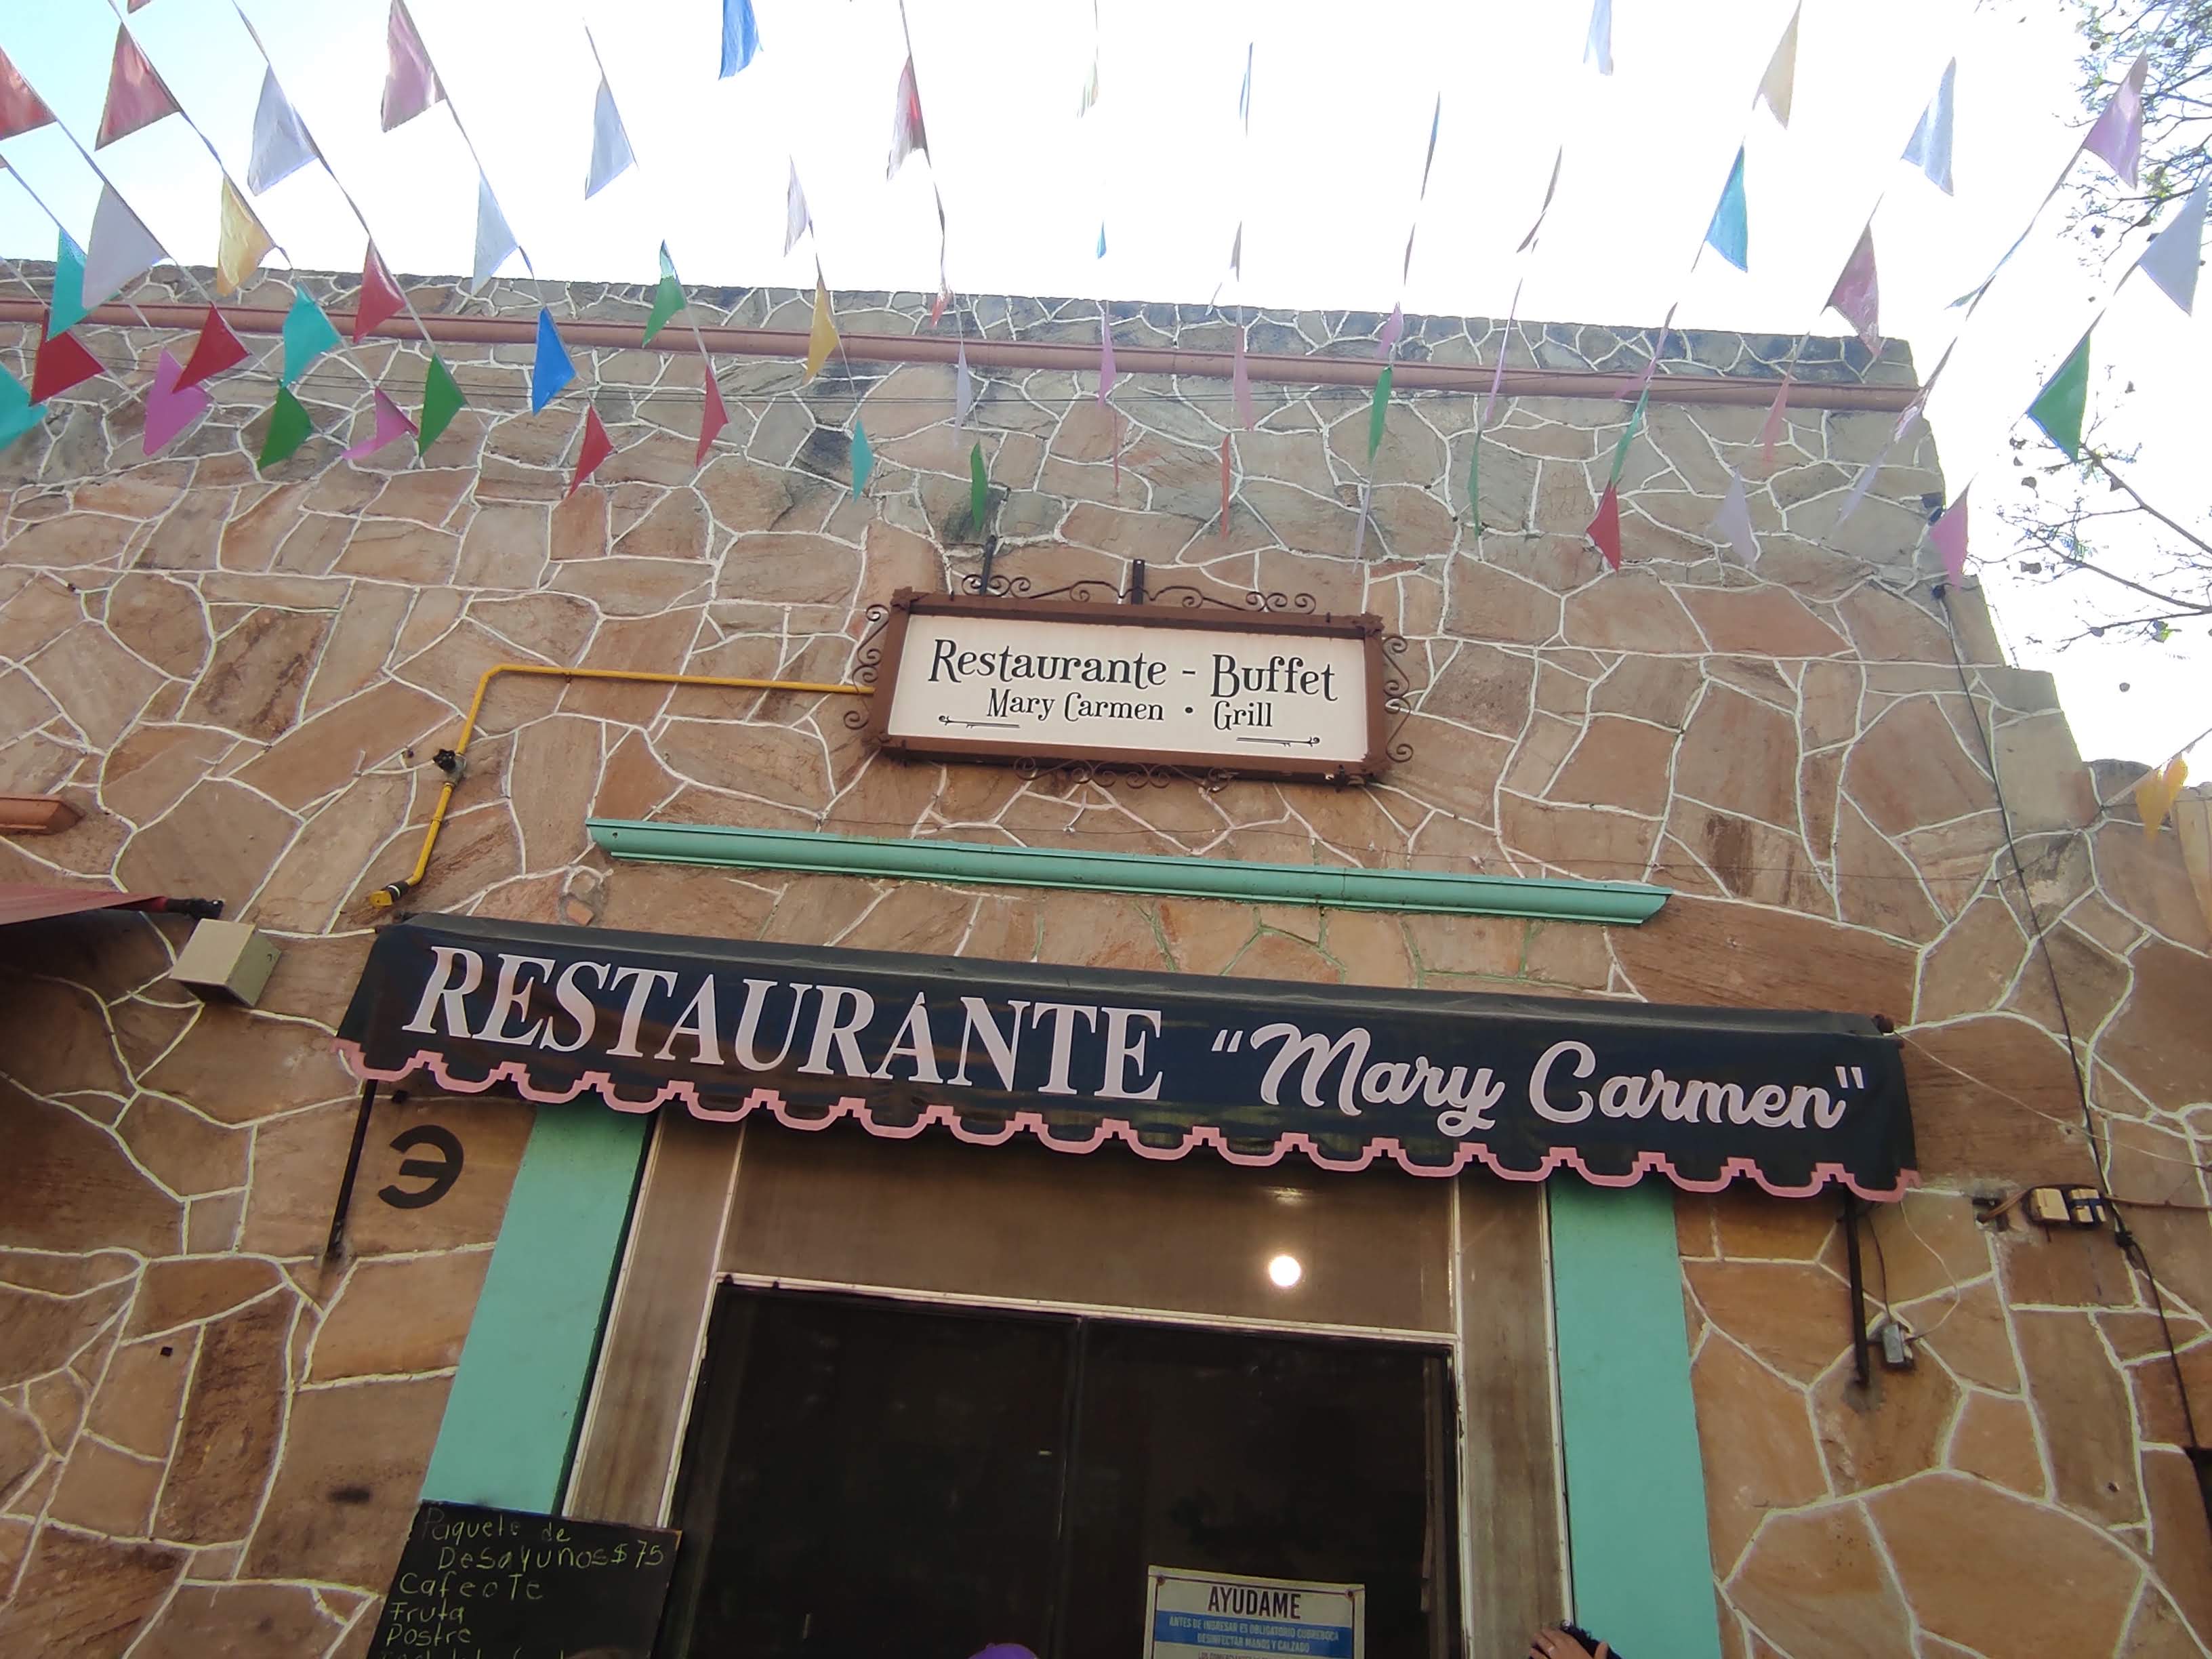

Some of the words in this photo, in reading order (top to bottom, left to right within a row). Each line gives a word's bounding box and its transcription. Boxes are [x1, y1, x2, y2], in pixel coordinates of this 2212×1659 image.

[928, 639, 1166, 689] Restaurante
[1210, 654, 1338, 701] Buffet
[987, 688, 1055, 721] Mary
[1064, 692, 1164, 722] Carmen
[1214, 700, 1272, 731] Grill
[401, 946, 1164, 1101] RESTAURANTE
[542, 1522, 571, 1542] de
[390, 1597, 466, 1624] Fruta
[1208, 1585, 1302, 1620] AYUDAME
[386, 1622, 472, 1647] Postre
[1169, 1616, 1192, 1628] ANTES
[1193, 1618, 1202, 1629] DE
